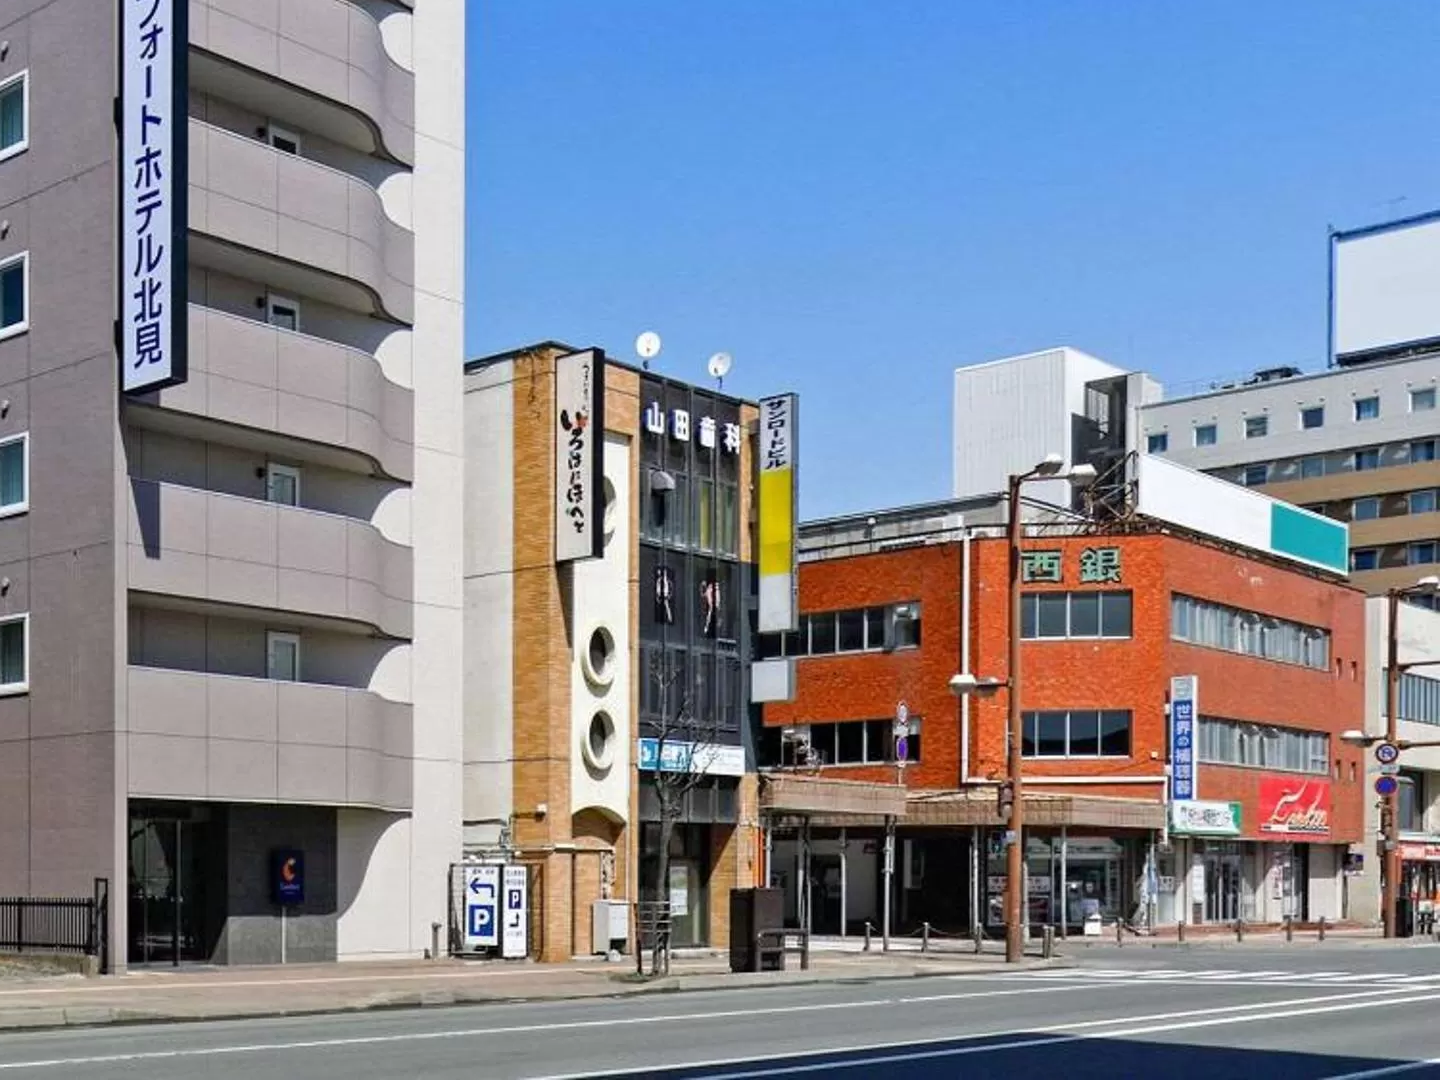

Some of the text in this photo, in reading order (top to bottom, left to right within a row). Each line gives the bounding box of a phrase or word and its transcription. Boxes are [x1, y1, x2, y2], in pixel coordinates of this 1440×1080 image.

[644, 400, 741, 455] 山田歯科
[560, 409, 587, 533] いろはにほへと
[473, 908, 491, 934] P
